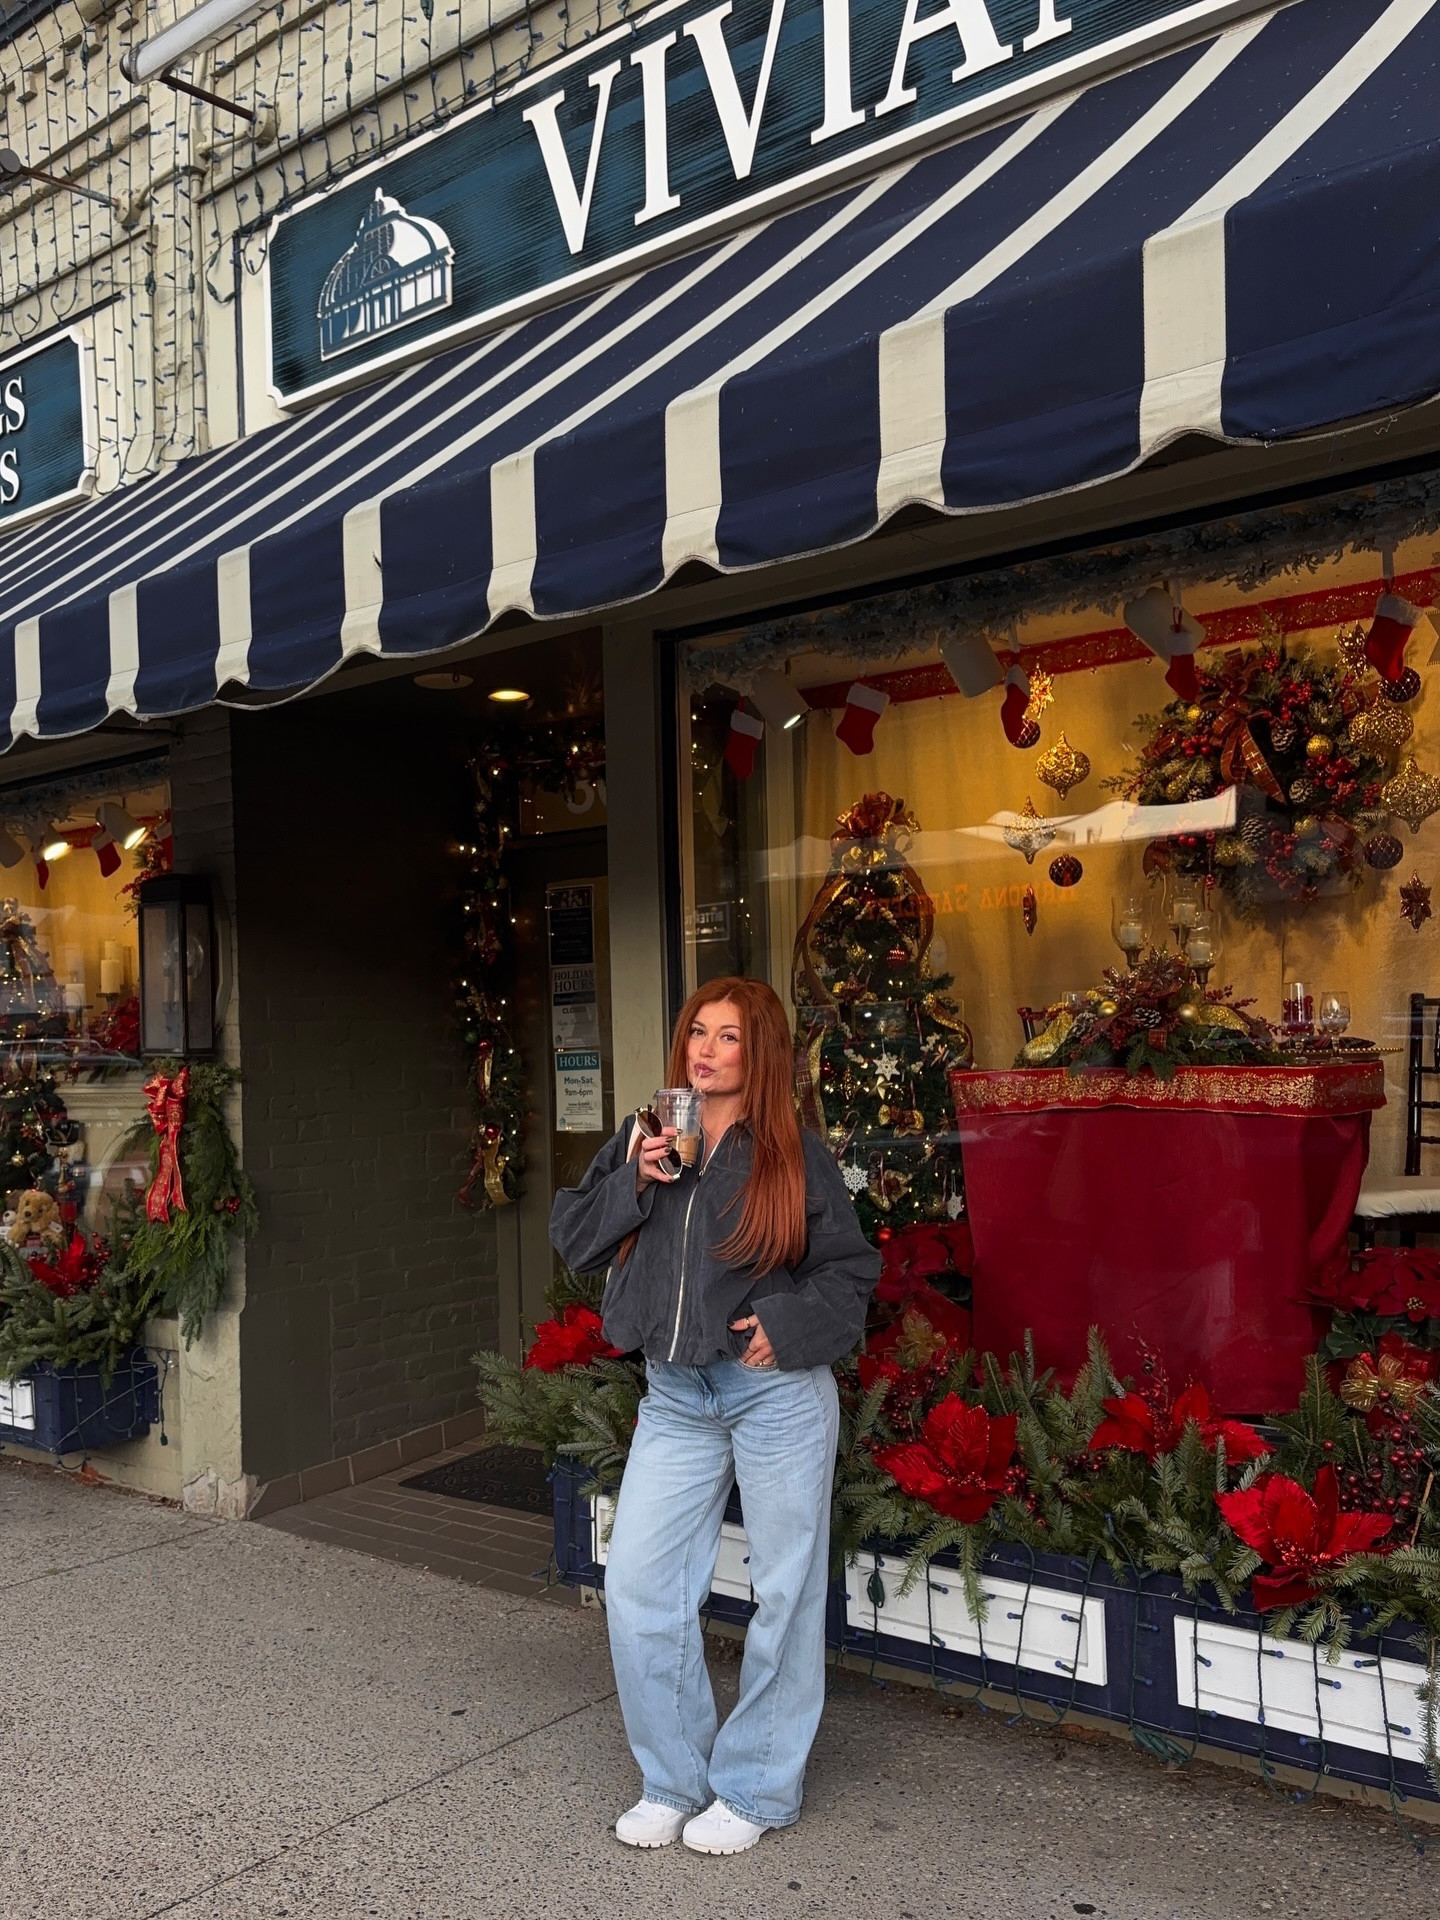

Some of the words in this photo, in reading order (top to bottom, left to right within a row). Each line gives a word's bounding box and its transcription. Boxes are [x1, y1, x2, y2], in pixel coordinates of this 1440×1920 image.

[523, 0, 1072, 255] VIVIA
[0, 376, 25, 434] S
[560, 1055, 597, 1067] HOURS
[564, 1076, 593, 1084] Mon-Sat
[565, 1088, 593, 1098] 9am-6pm
